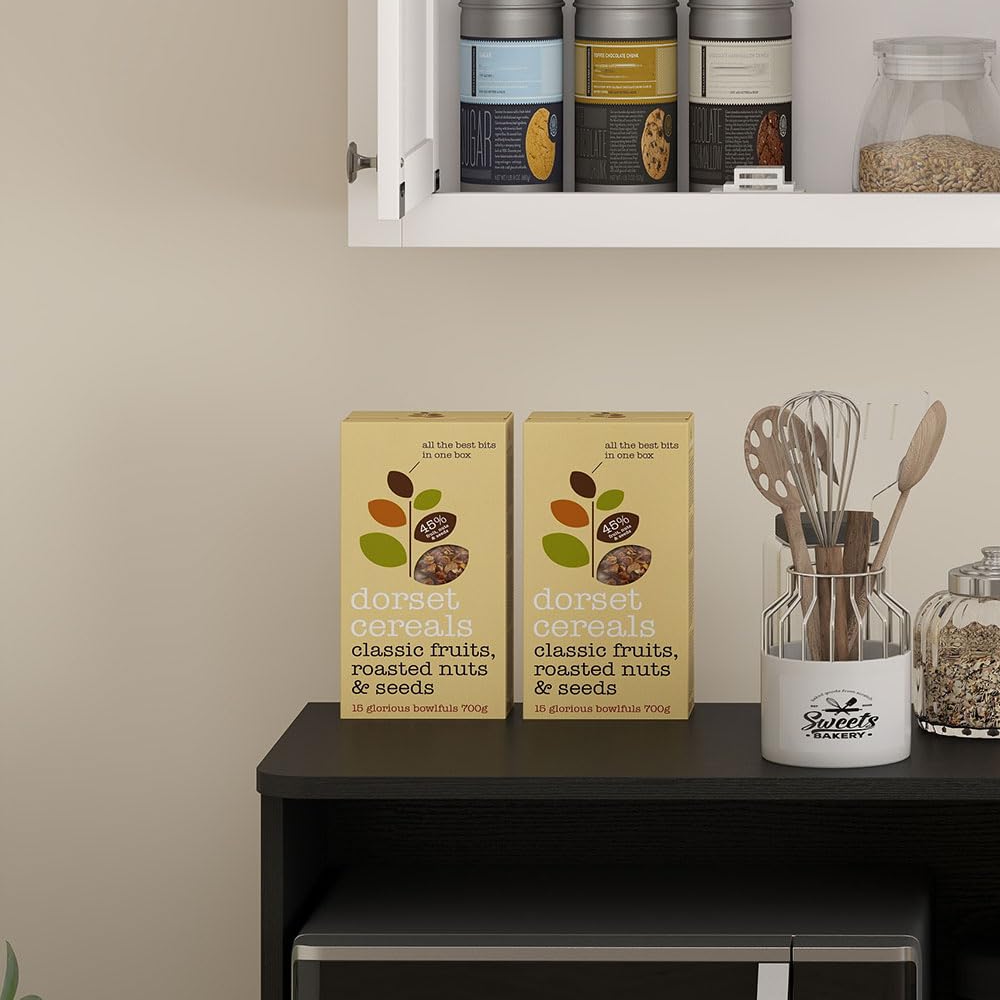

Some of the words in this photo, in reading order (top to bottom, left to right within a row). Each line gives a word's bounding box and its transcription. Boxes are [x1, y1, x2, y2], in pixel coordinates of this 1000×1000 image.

[462, 108, 492, 168] UGAR
[422, 441, 434, 449] all
[437, 441, 454, 449] the
[455, 441, 476, 449] best
[478, 441, 496, 449] bits
[604, 441, 617, 449] all
[619, 441, 636, 449] the
[638, 441, 658, 449] best
[660, 441, 679, 449] bits
[422, 451, 432, 459] in
[454, 451, 472, 459] box
[604, 451, 615, 459] in
[636, 451, 654, 459] box
[420, 515, 447, 534] 45%
[602, 515, 630, 534] 45%
[350, 587, 460, 611] dorset
[533, 587, 642, 611] dorset
[350, 614, 473, 638] cereals
[533, 615, 656, 638] cereals
[351, 642, 424, 658] classic
[430, 642, 496, 660] fruits,
[534, 642, 606, 658] classic
[613, 642, 678, 660] fruits,
[351, 662, 433, 677] roasted
[438, 662, 488, 677] nuts
[534, 662, 616, 677] roasted
[621, 662, 671, 677] nuts
[351, 680, 370, 696] &
[376, 680, 434, 696] seeds
[534, 680, 552, 696] &
[558, 680, 617, 696] seeds
[352, 704, 363, 714] 15
[366, 704, 410, 716] glorious
[413, 704, 458, 714] bowlfuls
[461, 704, 488, 716] 700g
[534, 704, 546, 714] 15
[548, 704, 592, 716] glorious
[595, 704, 641, 714] bowlfuls
[644, 704, 671, 716] 700g
[801, 710, 879, 730] Sweets
[813, 732, 866, 740] BAKERY
